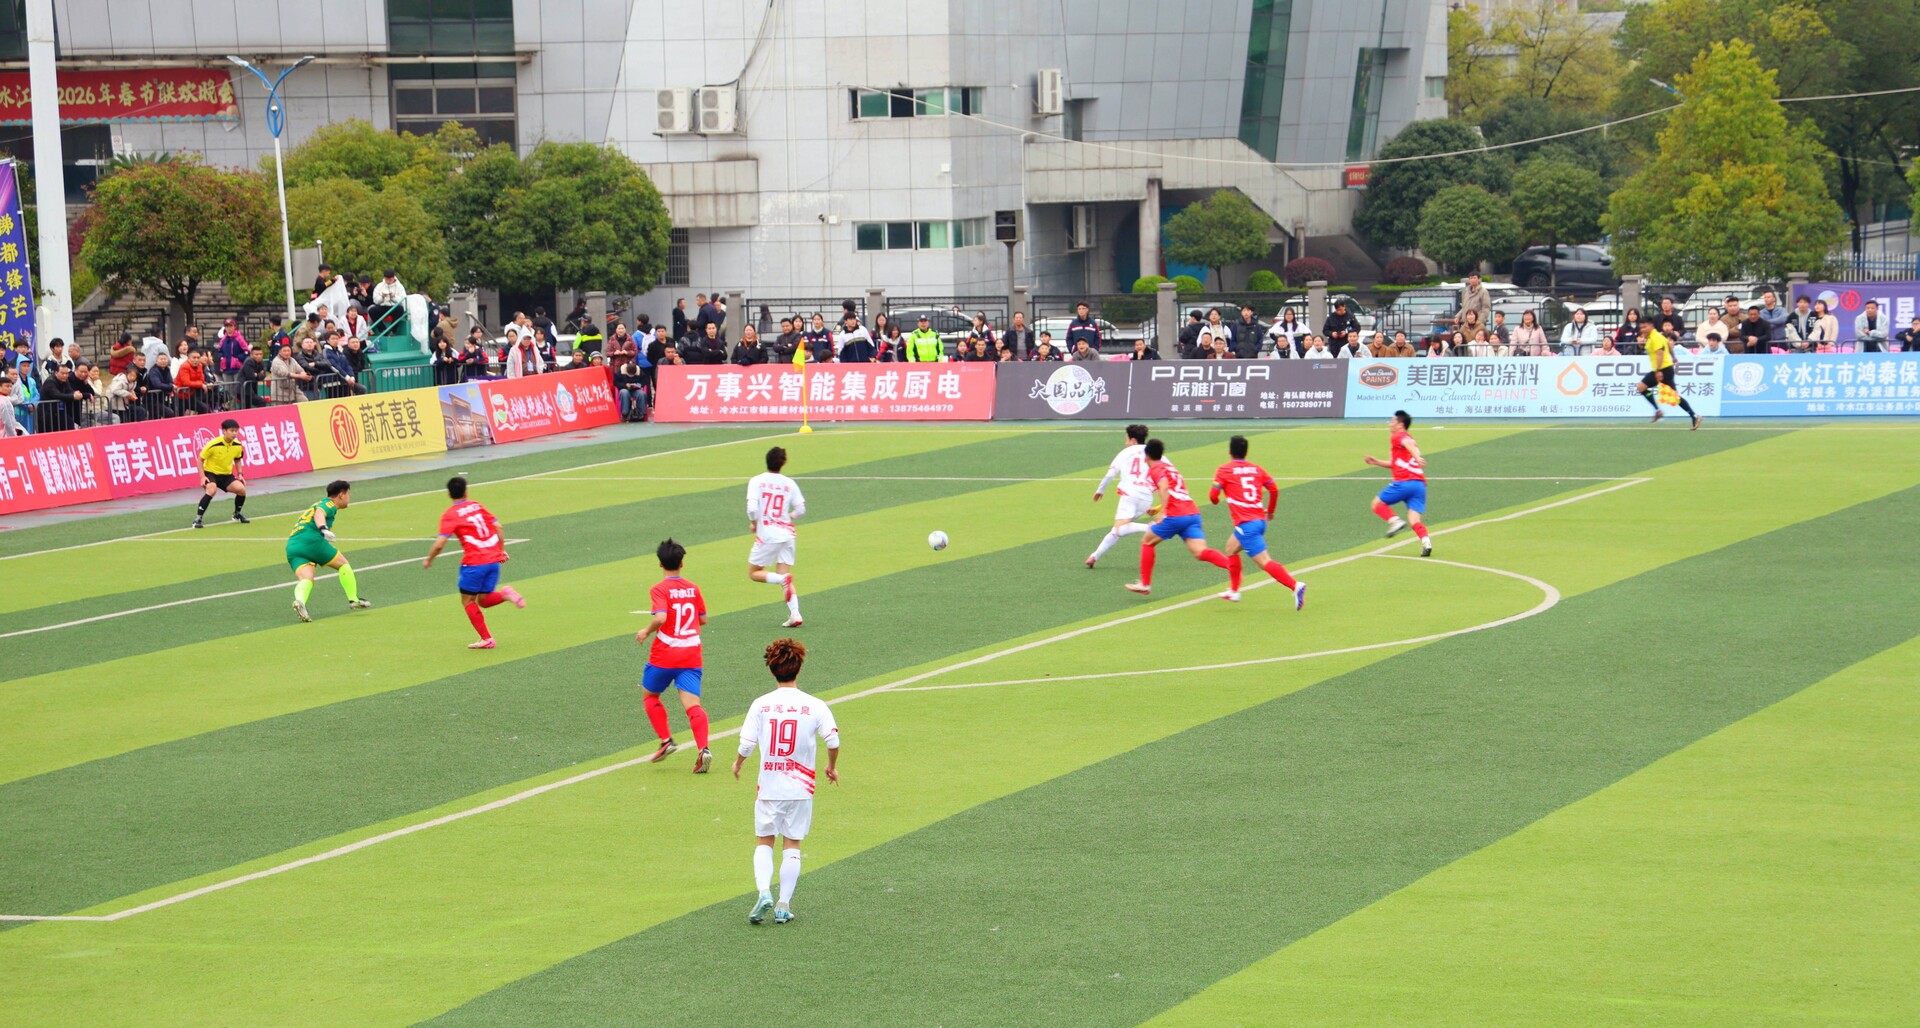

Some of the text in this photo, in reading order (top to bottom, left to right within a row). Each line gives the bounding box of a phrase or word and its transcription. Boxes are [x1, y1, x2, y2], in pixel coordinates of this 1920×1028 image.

[1151, 365, 1271, 381] PAIYA
[1406, 363, 1539, 387] 美国邓恩涂料
[1596, 362, 1714, 377] COLEC
[1772, 360, 1919, 386] 冷水江市鸿泰保
[684, 370, 962, 402] 万事兴智能集成厨电
[1028, 376, 1106, 404] 大国品牌
[1171, 382, 1247, 398] 派雅门窗
[1483, 388, 1538, 400] PAINTS
[1786, 386, 1837, 399] 保安服务
[358, 397, 423, 444] 蔚禾喜宴
[104, 433, 199, 486] 南芙山庄
[219, 420, 304, 468] 遇良缘
[1240, 476, 1258, 502] 5
[761, 492, 785, 518] 79
[671, 602, 697, 636] 12
[769, 718, 798, 757] 19
